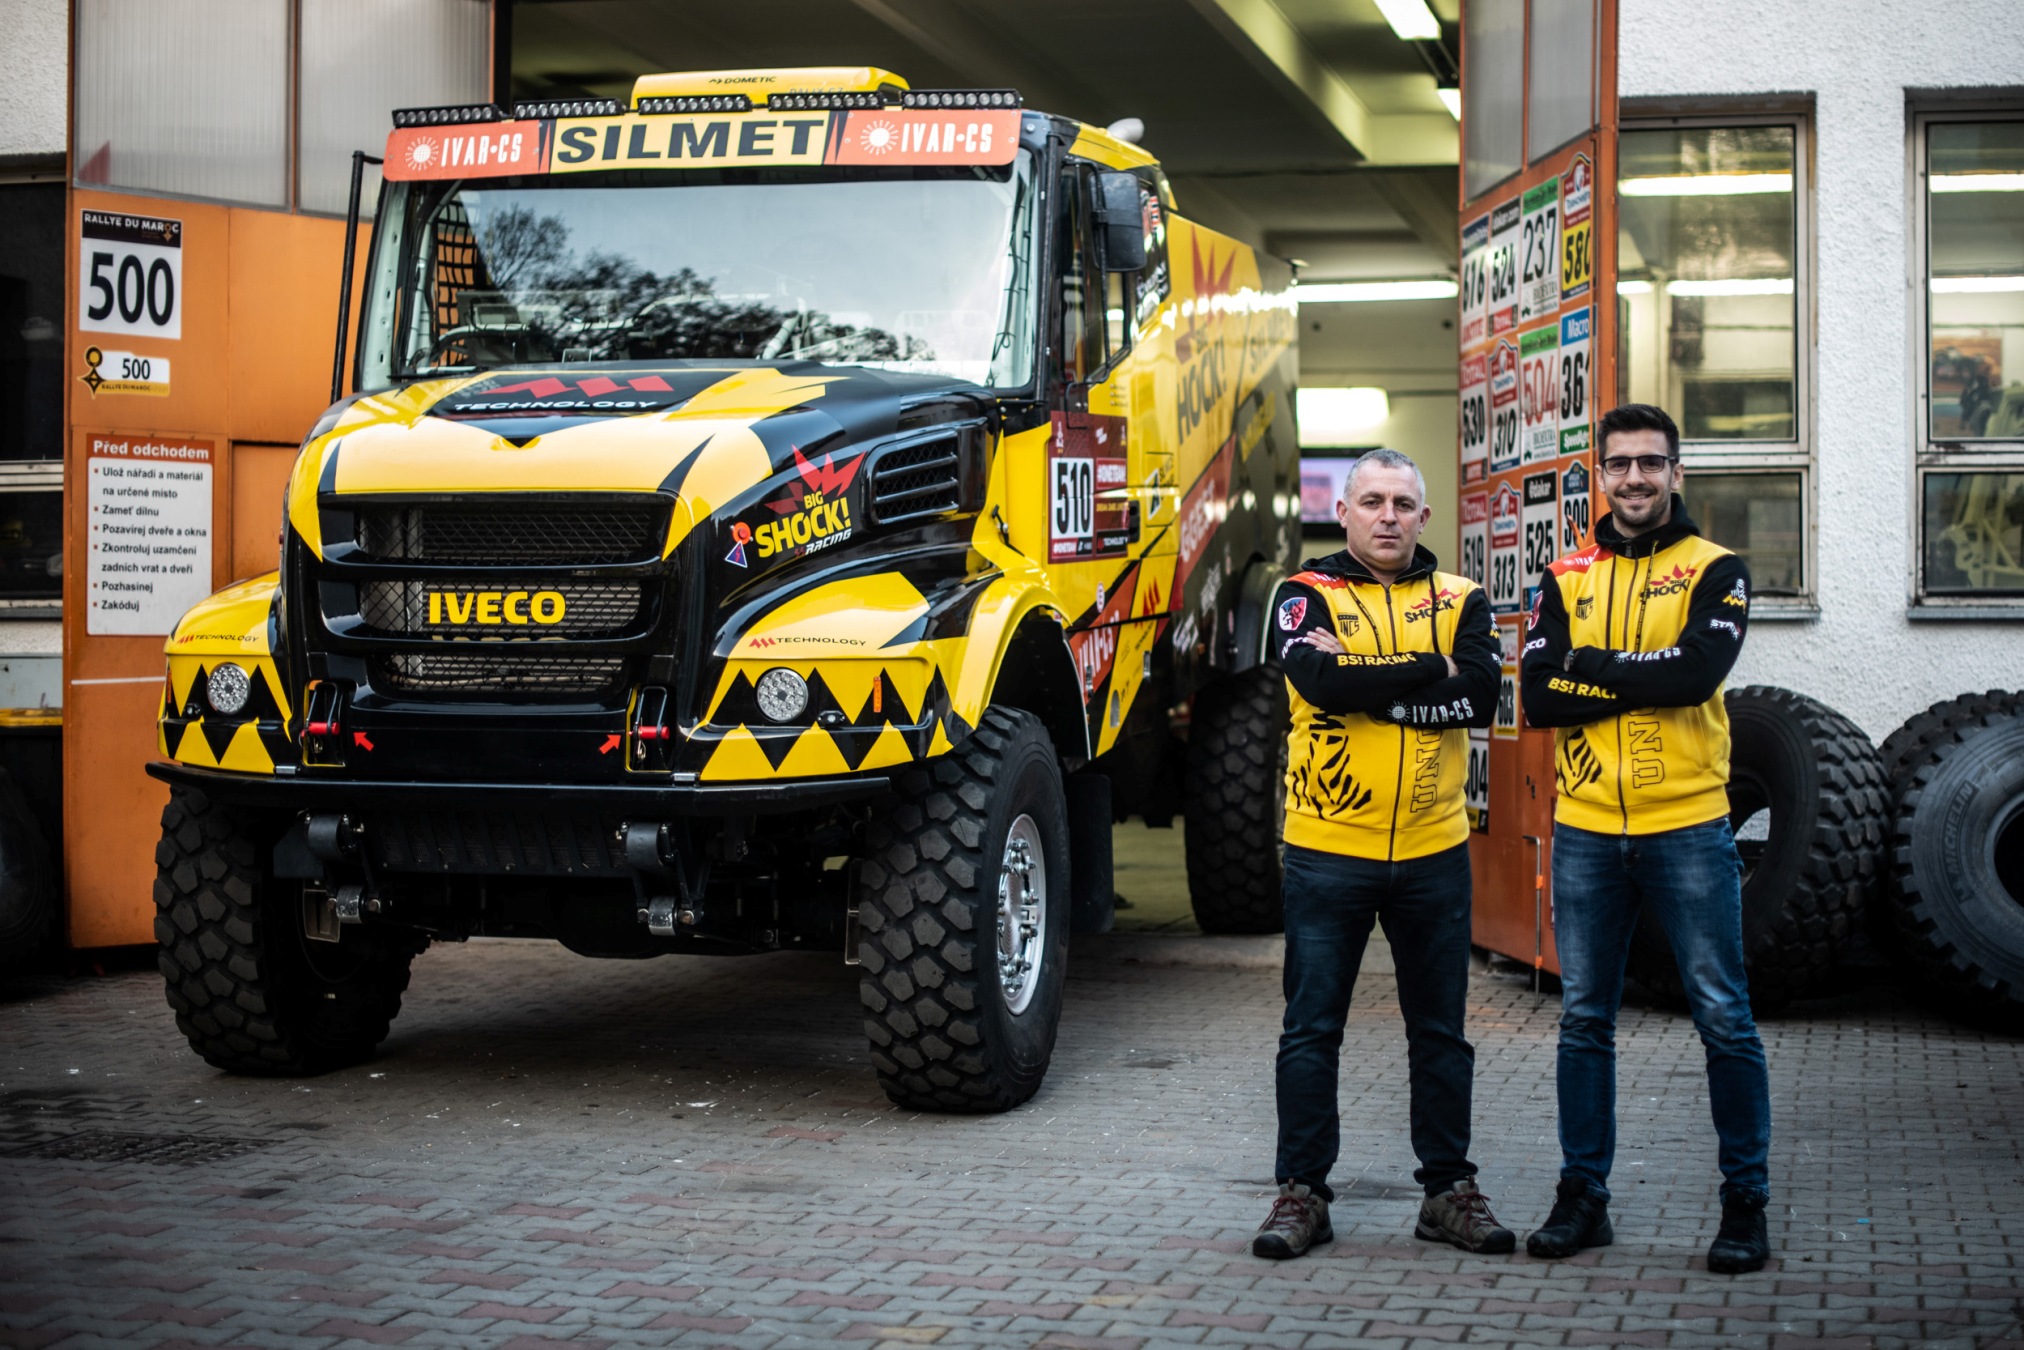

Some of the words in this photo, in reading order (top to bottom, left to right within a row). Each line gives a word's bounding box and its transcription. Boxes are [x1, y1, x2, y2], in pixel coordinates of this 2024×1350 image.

[724, 76, 776, 84] DOMETIC
[557, 119, 828, 164] SILMET
[84, 213, 122, 226] RALLYE
[125, 218, 139, 228] DU
[141, 221, 179, 234] MAROC
[1523, 207, 1557, 284] 237
[88, 251, 174, 326] 500
[122, 358, 151, 380] 500
[1523, 355, 1556, 427] 504
[1561, 351, 1590, 420] 36
[454, 400, 658, 412] TECHNOLOGY
[93, 440, 128, 455] Před
[133, 443, 208, 460] odchodem
[103, 467, 123, 477] Ulož
[167, 471, 203, 481] materiál
[103, 487, 114, 495] na
[117, 488, 149, 497] určené
[804, 491, 824, 509] BIG
[1056, 462, 1090, 535] 510
[148, 526, 174, 536] dveře
[177, 528, 182, 536] a
[185, 527, 207, 537] okna
[754, 497, 852, 558] SHOCK!
[102, 543, 150, 556] Zkontroluj
[805, 528, 852, 555] RACING
[1526, 520, 1554, 575] 525
[141, 564, 159, 573] vrat
[1493, 553, 1516, 600] 313
[102, 600, 140, 612] Zakóduj
[428, 591, 566, 625] IVECO
[195, 634, 259, 642] TECHNOLOGY
[776, 637, 866, 647] TECHNOLOGY
[1337, 655, 1363, 666] BS!
[1364, 653, 1417, 666] RACING
[1548, 677, 1574, 692] BS!
[1465, 748, 1488, 802] 04
[1944, 783, 1973, 875] MICHELIN
